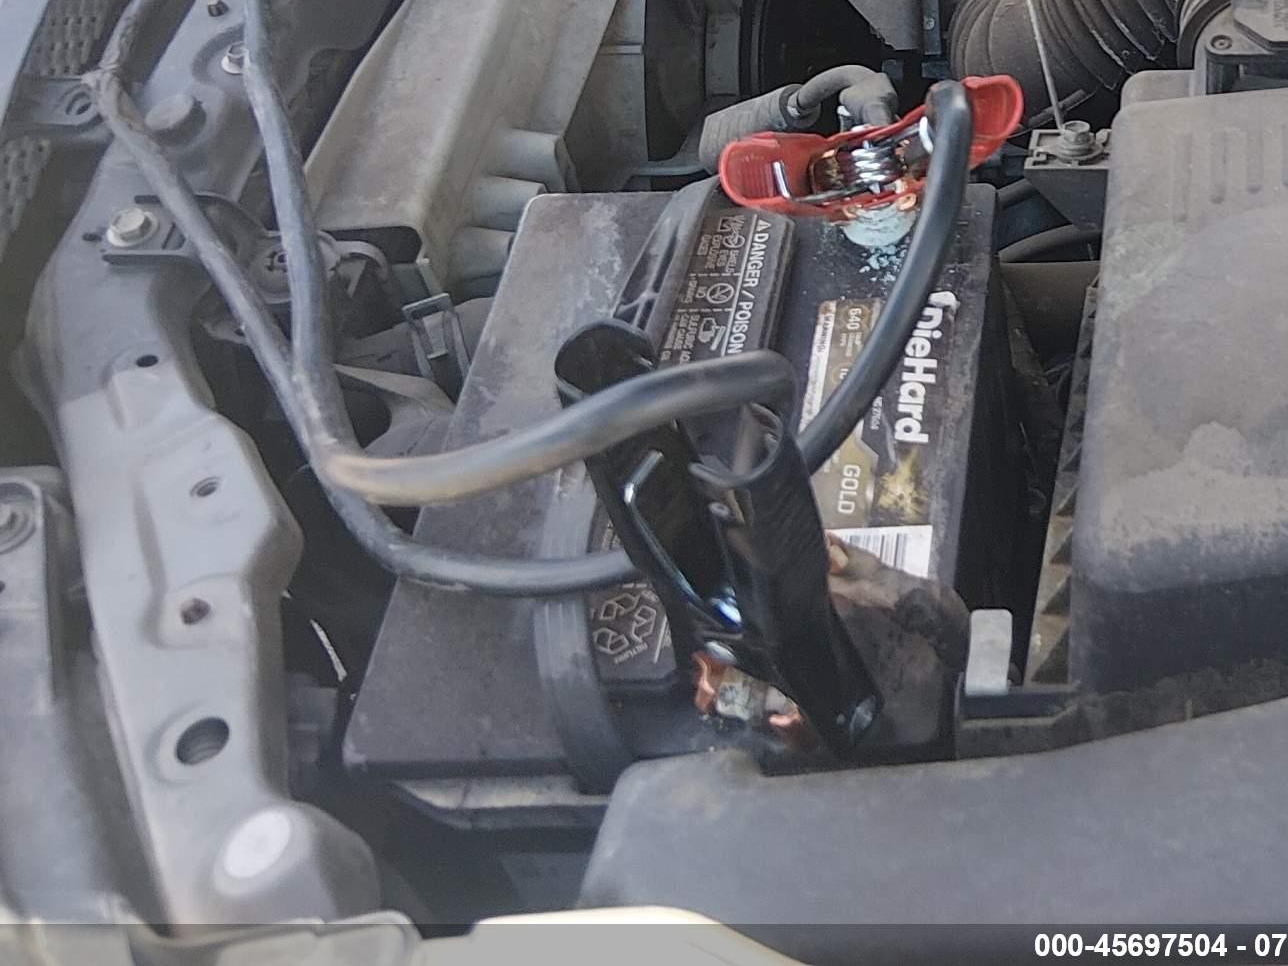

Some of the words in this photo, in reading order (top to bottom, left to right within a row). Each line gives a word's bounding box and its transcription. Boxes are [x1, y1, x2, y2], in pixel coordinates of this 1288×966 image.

[743, 233, 769, 288] DANGER
[728, 301, 753, 354] POISON
[846, 307, 863, 330] 640
[836, 464, 861, 516] GOLD
